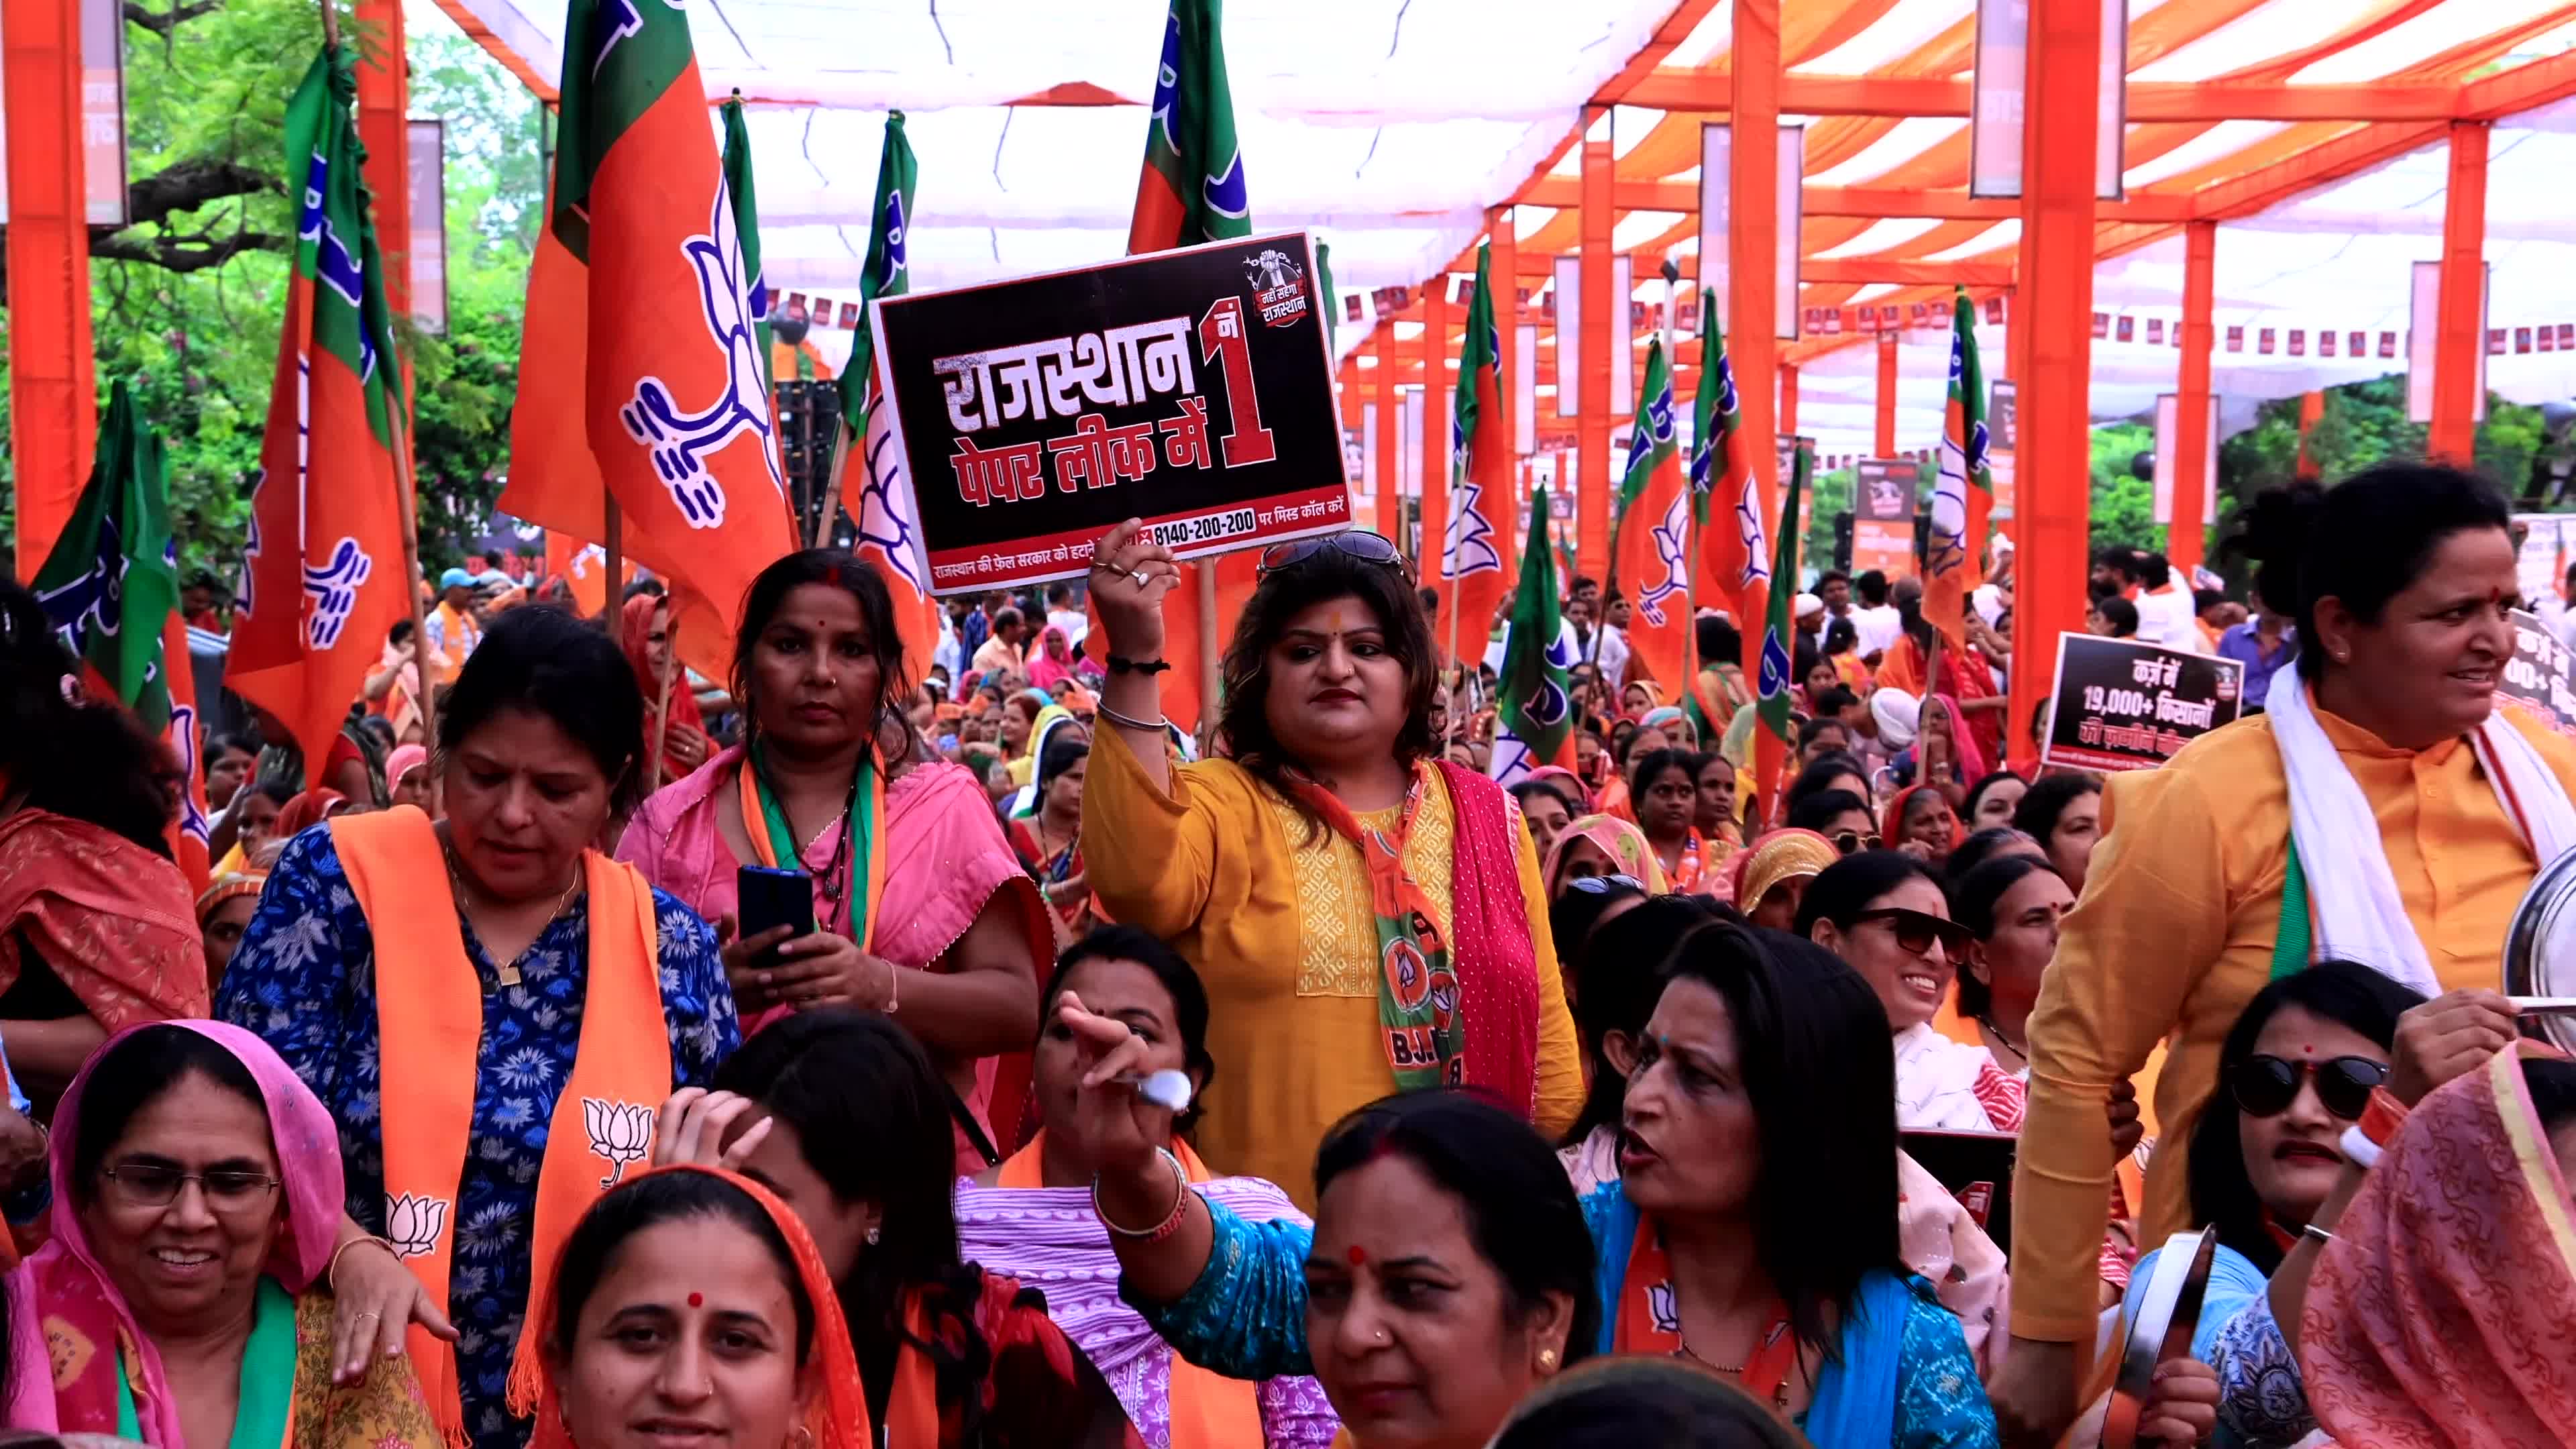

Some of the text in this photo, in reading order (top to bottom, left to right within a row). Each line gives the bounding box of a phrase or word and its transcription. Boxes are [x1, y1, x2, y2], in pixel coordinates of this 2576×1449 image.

[1214, 303, 1239, 339] नं
[1261, 296, 1306, 322] राजस्थान
[933, 316, 1196, 433] राजस्थान
[950, 396, 1212, 507] पेपर लीक में
[1153, 511, 1254, 547] 8140-200-200
[1257, 513, 1273, 527] पर
[1273, 506, 1299, 523] मिस्ड
[1299, 500, 1326, 517] कॉल
[1326, 494, 1345, 513] करें
[933, 562, 975, 580] राजस्थान
[977, 555, 993, 573] की
[1017, 549, 1052, 567] सरकार
[1053, 543, 1069, 561] को
[1069, 539, 1095, 559] हटाने
[2163, 657, 2183, 688] में
[2083, 686, 2216, 729] 19,000+ किसानों
